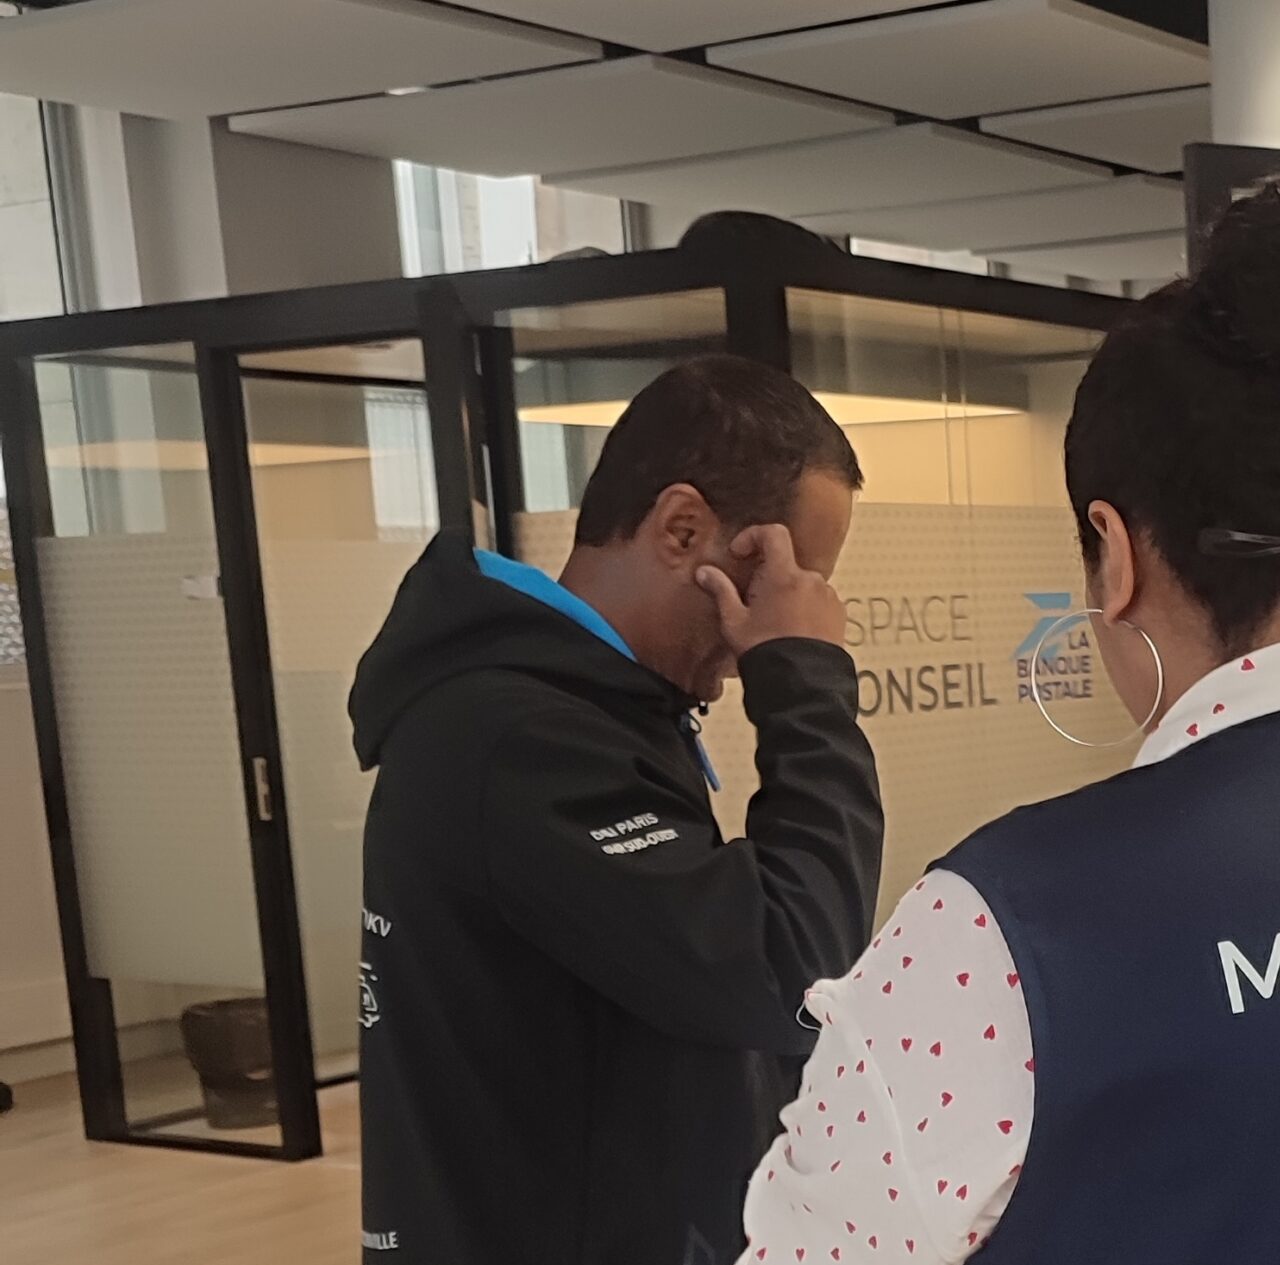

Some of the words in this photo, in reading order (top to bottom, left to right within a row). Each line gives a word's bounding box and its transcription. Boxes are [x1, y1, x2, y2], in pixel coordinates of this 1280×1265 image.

[846, 594, 973, 649] SPACE
[1068, 631, 1090, 651] LA
[1016, 655, 1092, 679] BANQUE
[858, 663, 999, 718] ONSEIL
[1017, 680, 1094, 704] POSTALE
[615, 812, 660, 835] PARIS
